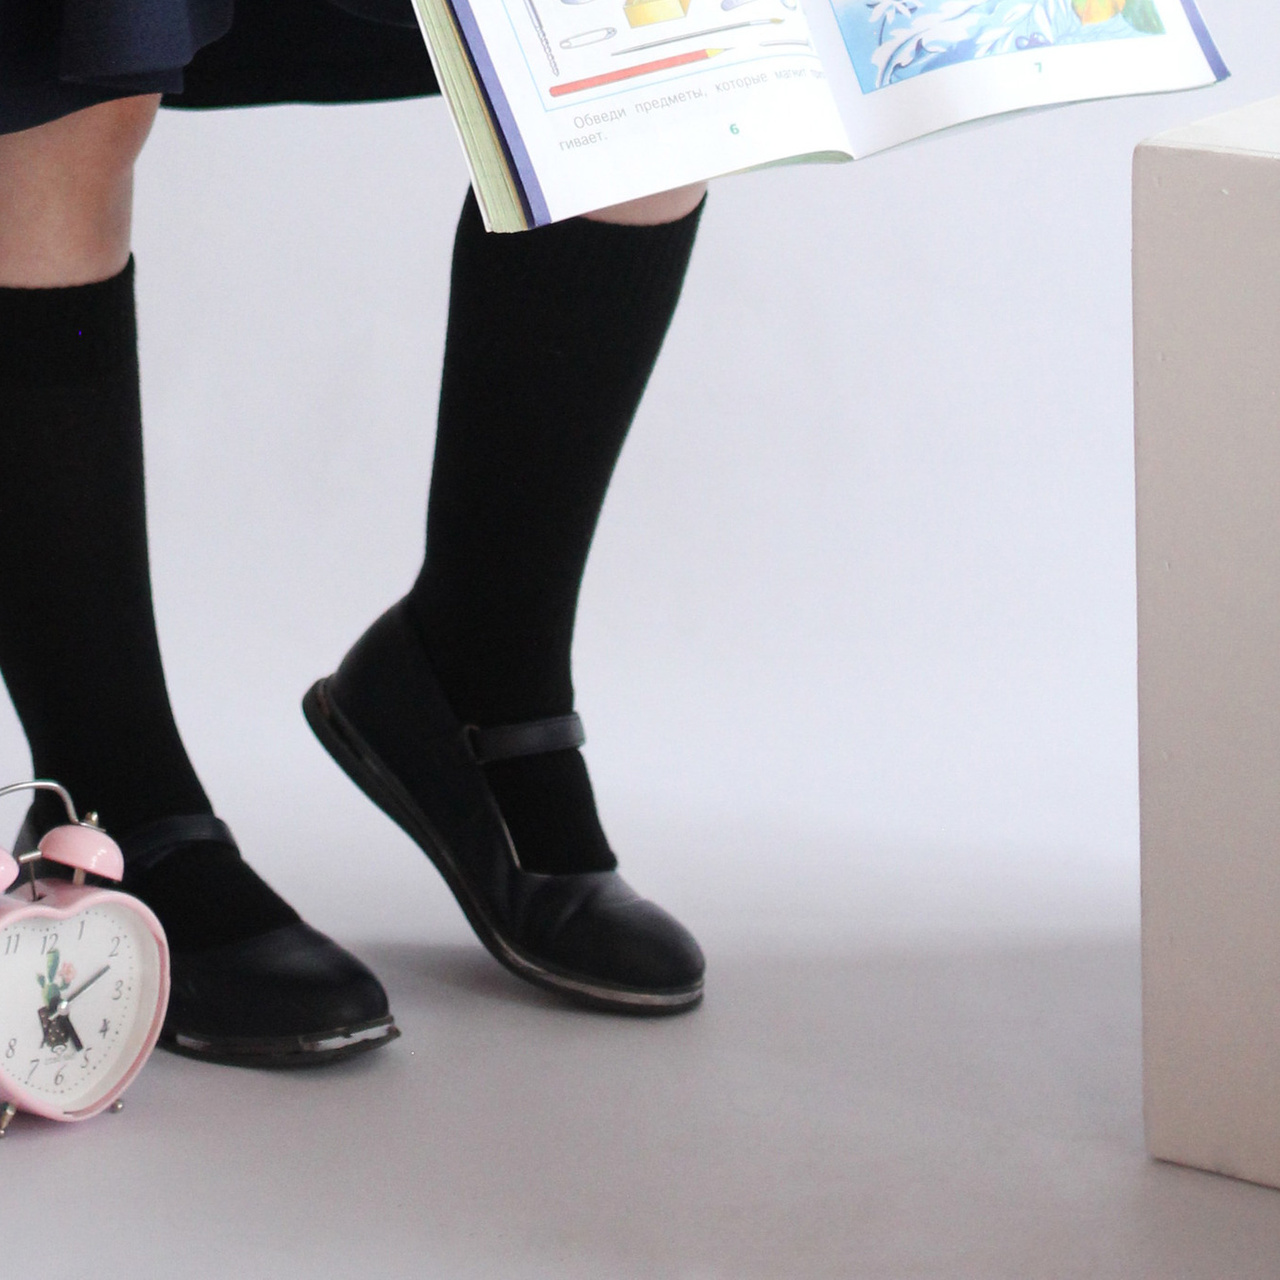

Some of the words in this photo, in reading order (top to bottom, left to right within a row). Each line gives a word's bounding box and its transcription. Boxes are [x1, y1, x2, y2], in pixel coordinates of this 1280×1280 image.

[574, 107, 627, 130] Обведи
[715, 70, 768, 94] которые
[728, 123, 740, 135] 6
[5, 934, 21, 955] 11
[41, 933, 59, 954] 12
[108, 936, 121, 957] 2
[113, 980, 123, 1000] 3
[99, 1018, 111, 1038] 4
[6, 1037, 17, 1059] 8
[81, 1047, 93, 1068] 5
[28, 1059, 39, 1080] 7
[54, 1065, 64, 1085] 6
